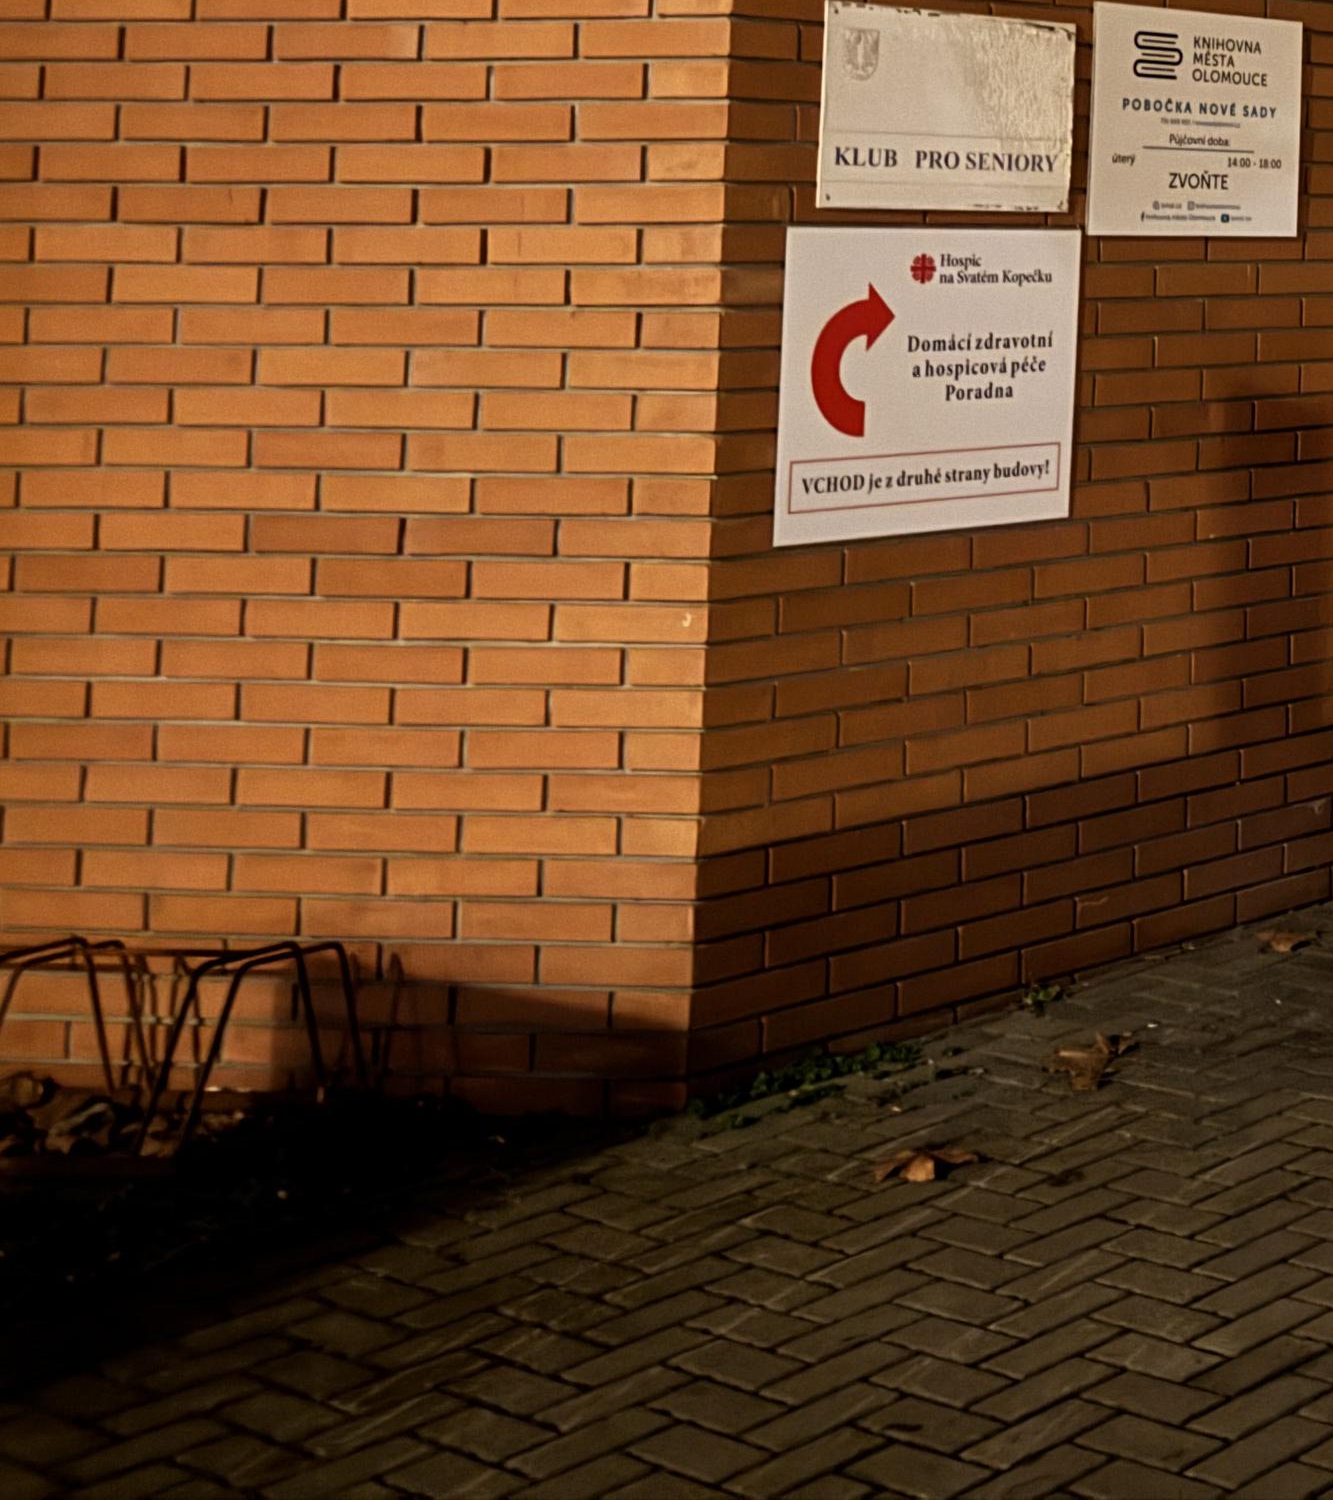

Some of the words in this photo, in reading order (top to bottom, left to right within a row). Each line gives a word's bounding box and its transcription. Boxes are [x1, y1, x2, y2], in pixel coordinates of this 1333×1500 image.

[1193, 36, 1262, 55] KNIHOVNA
[1192, 49, 1235, 68] MĚSTA
[1192, 68, 1268, 87] OLOMOUCE
[1122, 97, 1192, 114] POBOČKA
[1199, 102, 1236, 117] NOVÉ
[1243, 104, 1277, 119] SADY
[834, 146, 898, 168] KLUB
[915, 149, 960, 170] PRO
[965, 152, 1058, 172] SENIORY
[1112, 153, 1136, 166] úterý
[1168, 170, 1229, 190] ZVOŇTE
[940, 253, 982, 271] Hospic
[939, 274, 955, 284] na
[957, 269, 999, 284] Svatém
[1002, 268, 1053, 287] Kopečku
[907, 332, 972, 353] Domácí
[975, 330, 1054, 350] zdravotní
[912, 364, 921, 378] a
[924, 356, 1007, 381] hospicová
[1010, 355, 1047, 379] péče
[945, 381, 1014, 402] Poradna
[801, 474, 865, 495] VCHOD
[867, 473, 882, 494] je
[885, 475, 893, 488] z
[896, 466, 942, 488] druhé
[944, 466, 991, 485] strany
[993, 459, 1050, 480] budovy!
